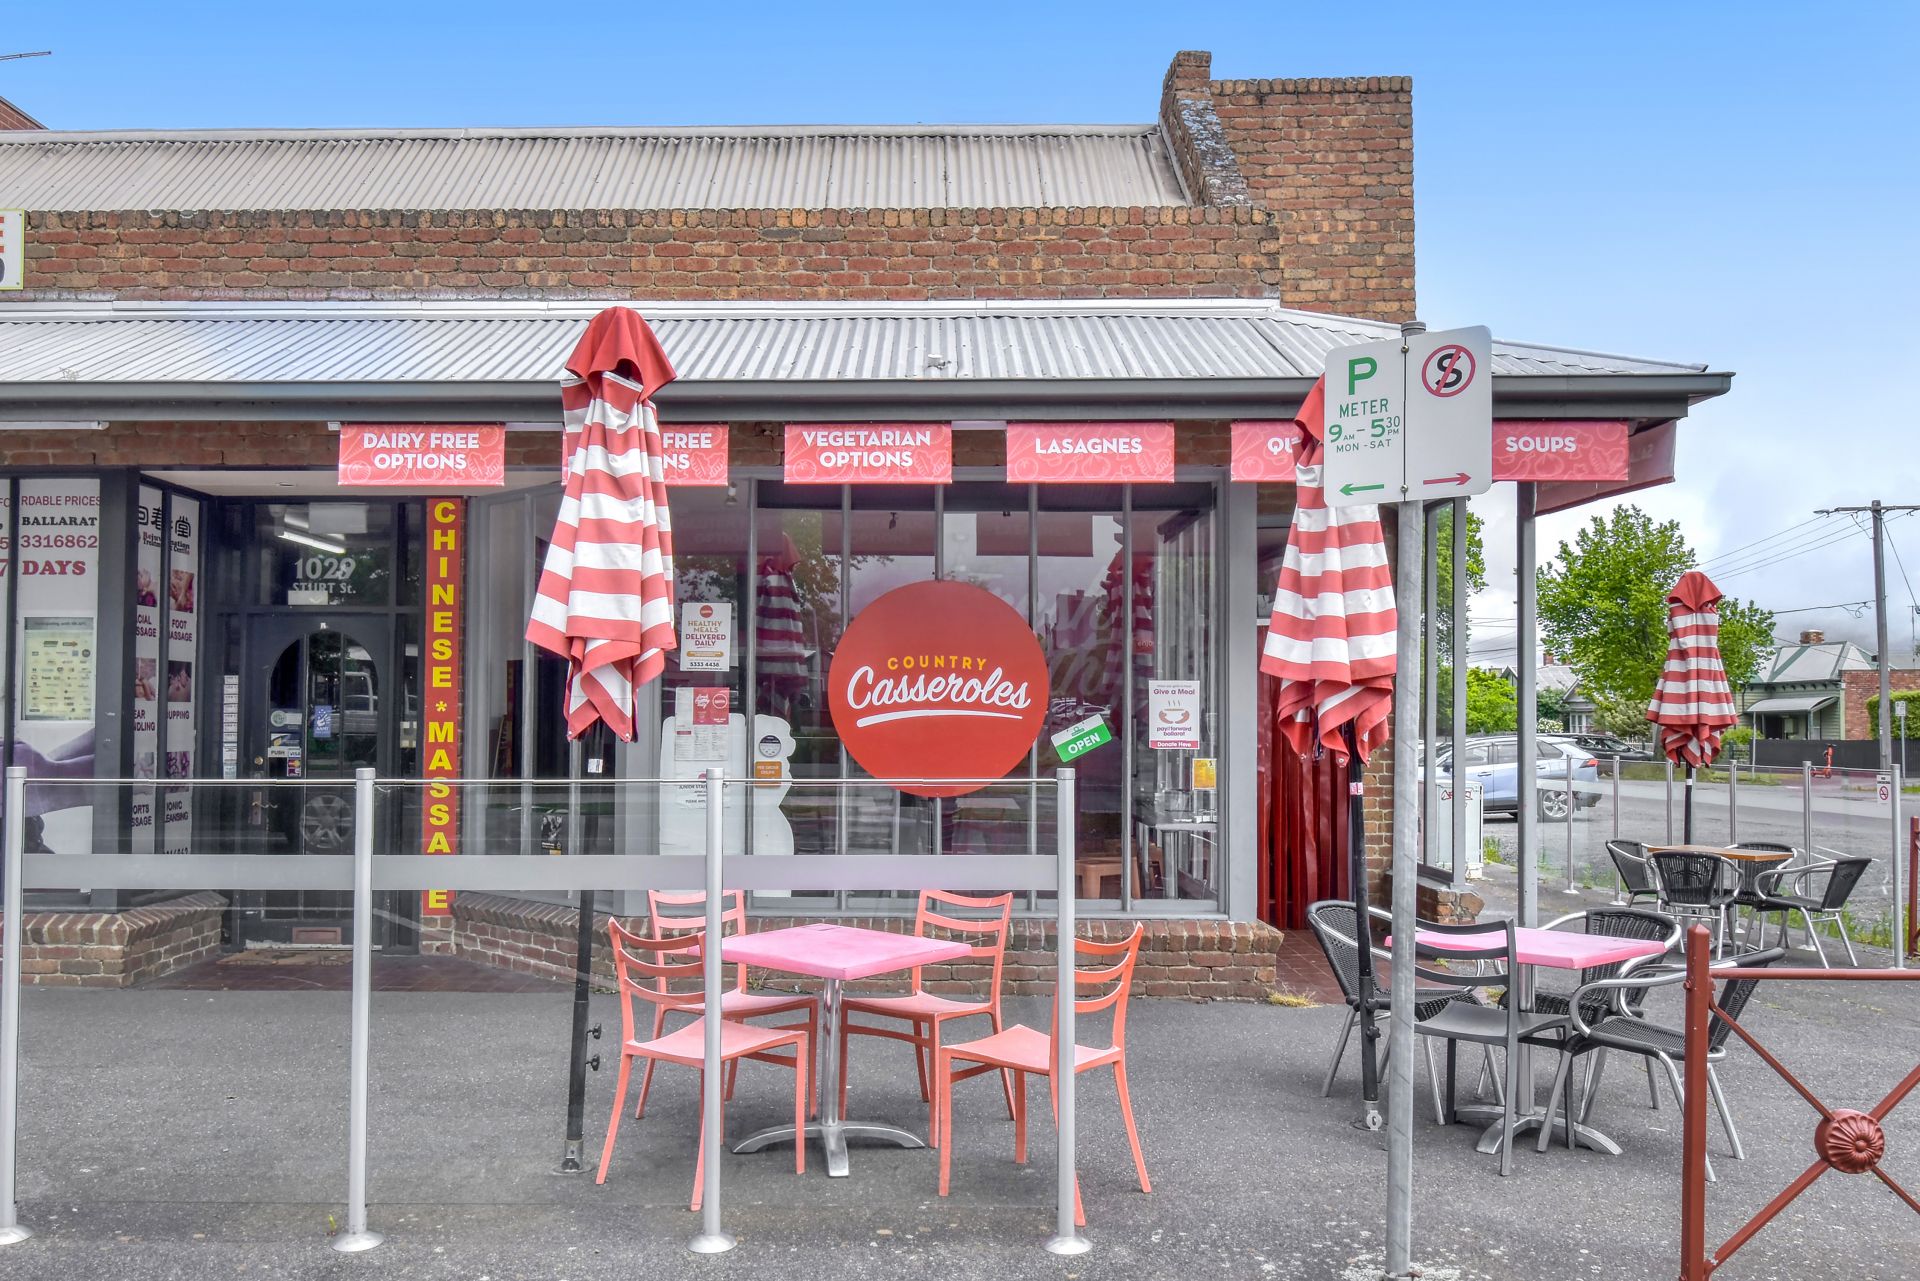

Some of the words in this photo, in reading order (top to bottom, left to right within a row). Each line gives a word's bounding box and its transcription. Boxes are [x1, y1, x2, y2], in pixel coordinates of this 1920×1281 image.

[1348, 357, 1378, 395] P
[1339, 398, 1389, 418] METER
[363, 432, 425, 449] DAIRY
[430, 432, 480, 449] FREE
[662, 432, 712, 449] FREE
[802, 430, 931, 447] VEGETARIAN
[1328, 423, 1343, 444] 9
[1387, 428, 1400, 436] PM
[1035, 437, 1143, 454] LASAGNES
[1336, 443, 1360, 453] MON
[1505, 436, 1577, 453] SOUPS
[373, 453, 467, 470] OPTIONS
[819, 451, 913, 468] OPTIONS
[64, 495, 100, 506] PRICES
[21, 515, 98, 527] BALLARAT
[22, 560, 87, 576] DAYS
[294, 557, 357, 580] 1029
[431, 501, 456, 688] CHINESE
[171, 618, 188, 630] FOOT
[887, 655, 987, 671] COUNTRY
[846, 665, 1032, 710] Casseroles
[166, 710, 190, 720] UPPING
[1067, 733, 1101, 754] OPEN
[427, 721, 455, 909] MASSAE
